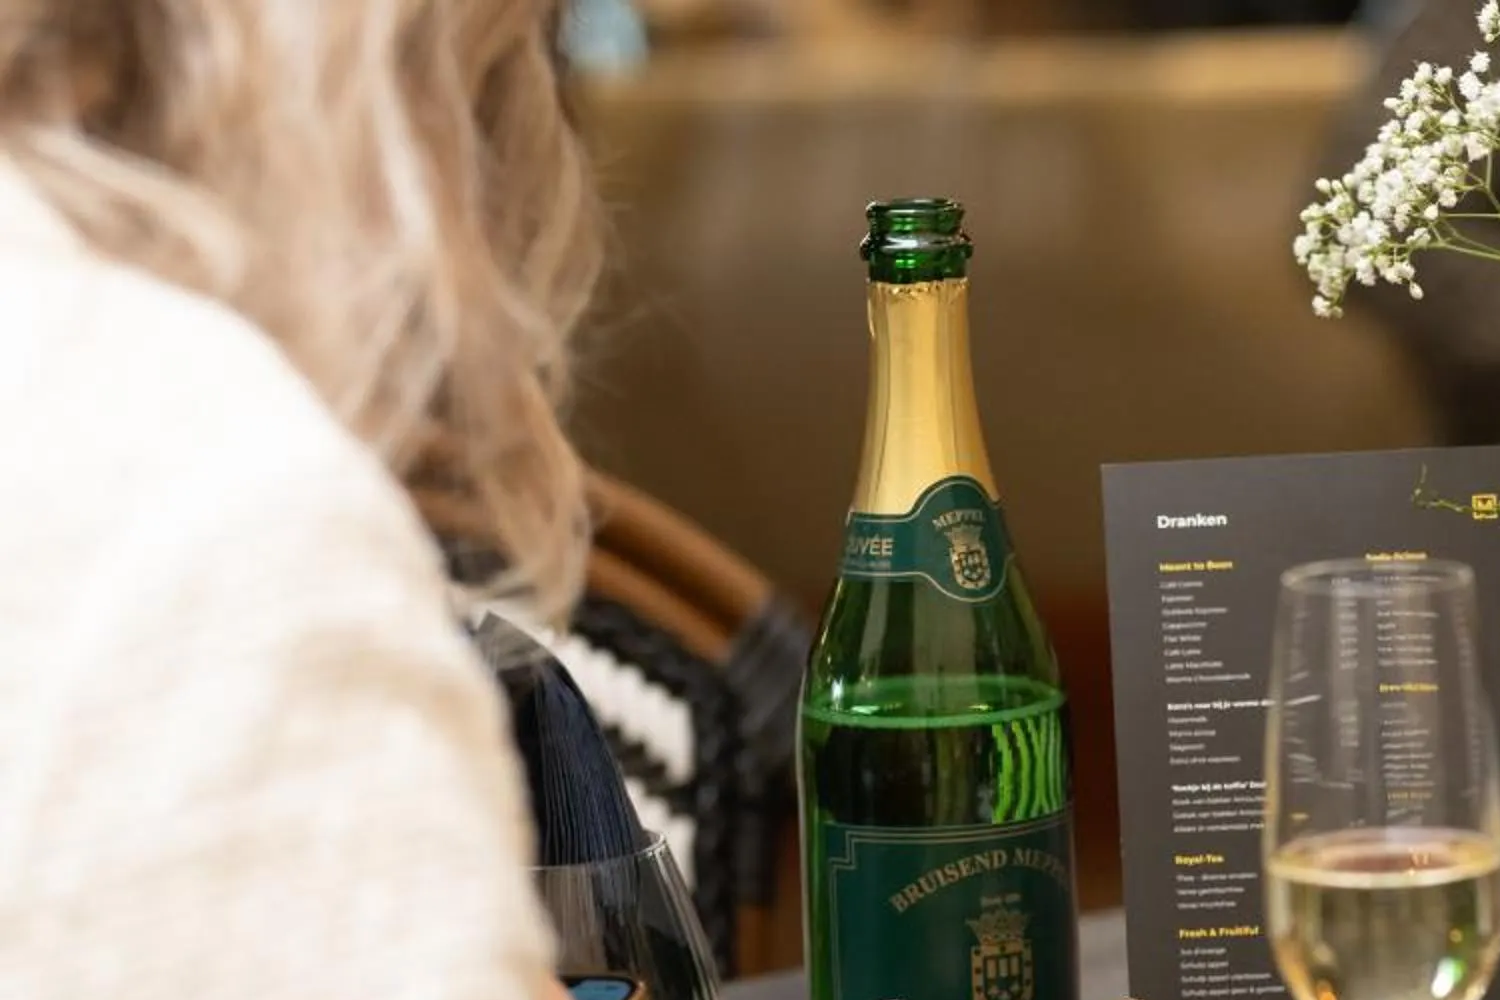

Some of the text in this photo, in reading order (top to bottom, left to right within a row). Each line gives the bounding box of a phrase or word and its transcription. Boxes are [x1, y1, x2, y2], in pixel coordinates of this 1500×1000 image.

[932, 509, 983, 530] MEPPEL
[1157, 513, 1228, 529] Dranken
[847, 533, 894, 557] UVÉE
[888, 849, 1008, 914] BRUISEND
[1179, 927, 1207, 938] Fresh
